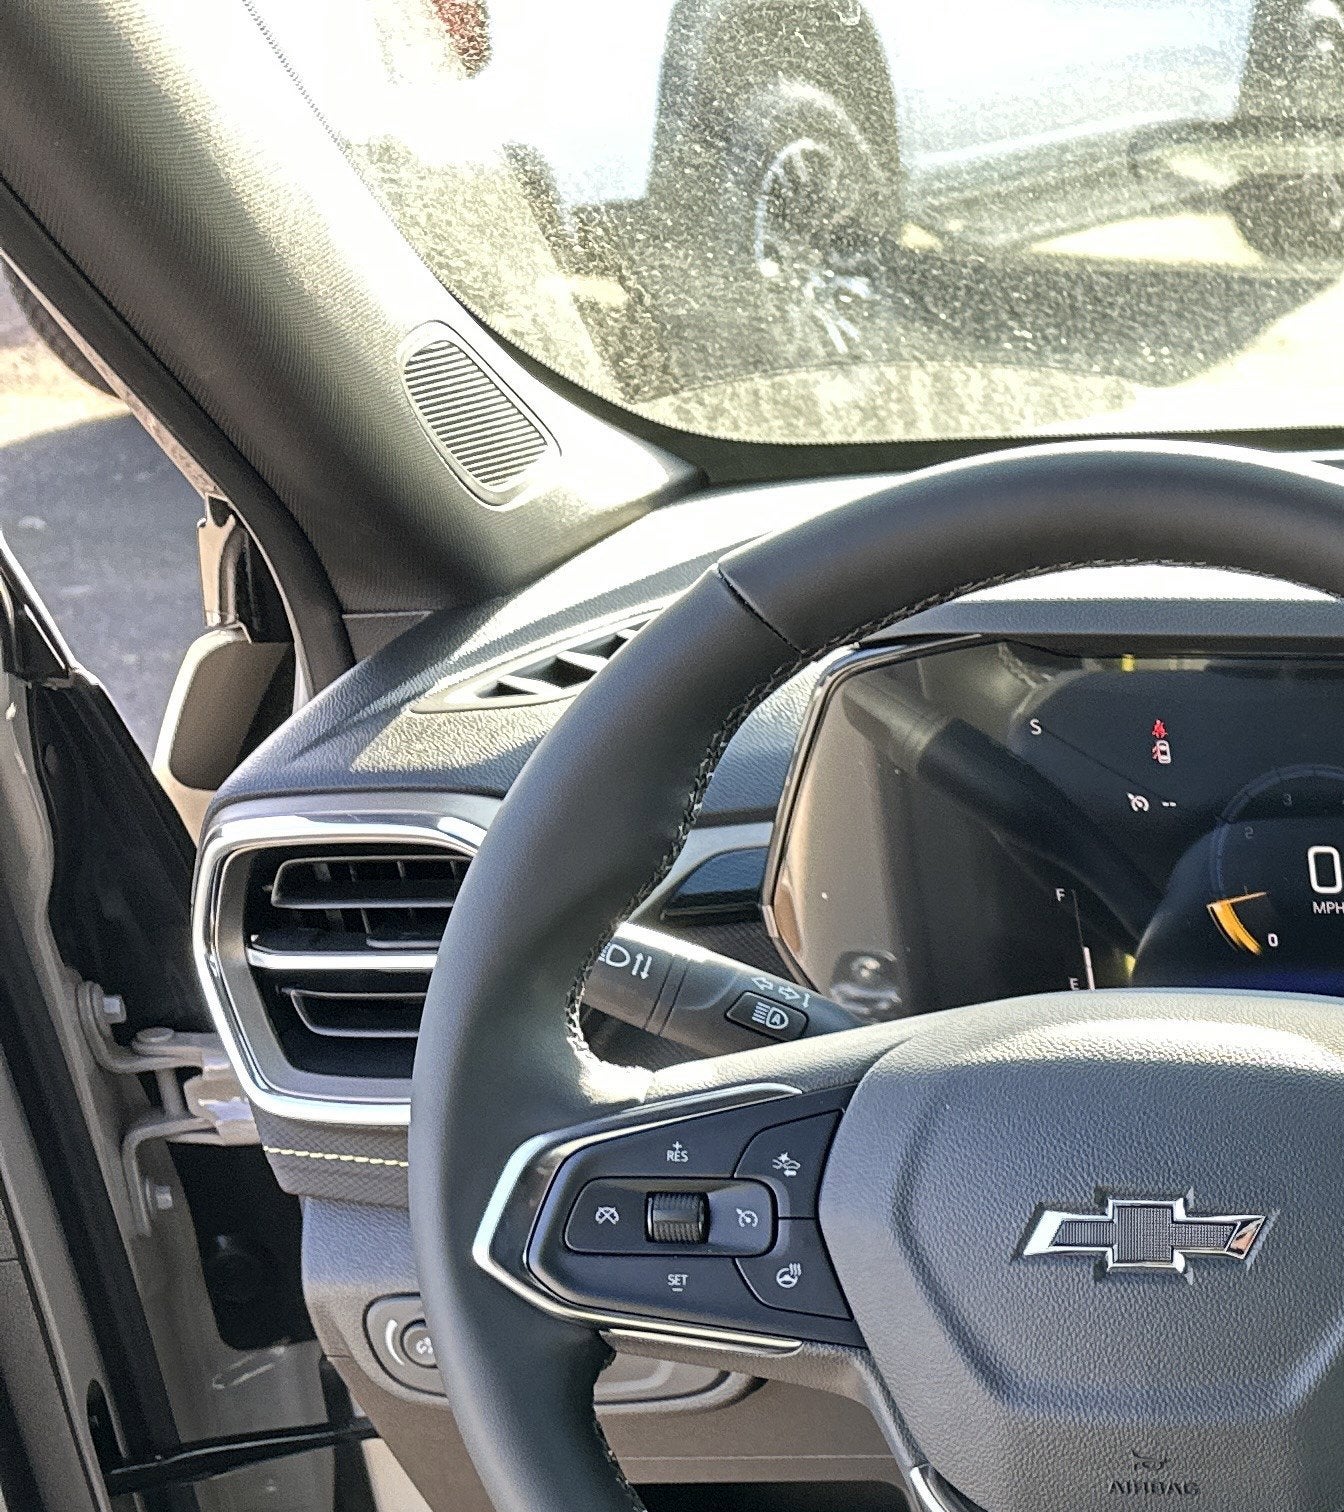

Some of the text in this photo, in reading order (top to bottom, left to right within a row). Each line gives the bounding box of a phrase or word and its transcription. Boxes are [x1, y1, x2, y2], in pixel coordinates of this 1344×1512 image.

[1030, 718, 1042, 735] S
[1307, 845, 1343, 894] 0
[1055, 888, 1066, 902] F
[1267, 933, 1279, 947] 0
[1069, 977, 1080, 991] E
[666, 1149, 689, 1163] RES
[667, 1273, 690, 1287] SET
[1108, 1480, 1200, 1496] AIRBAG
